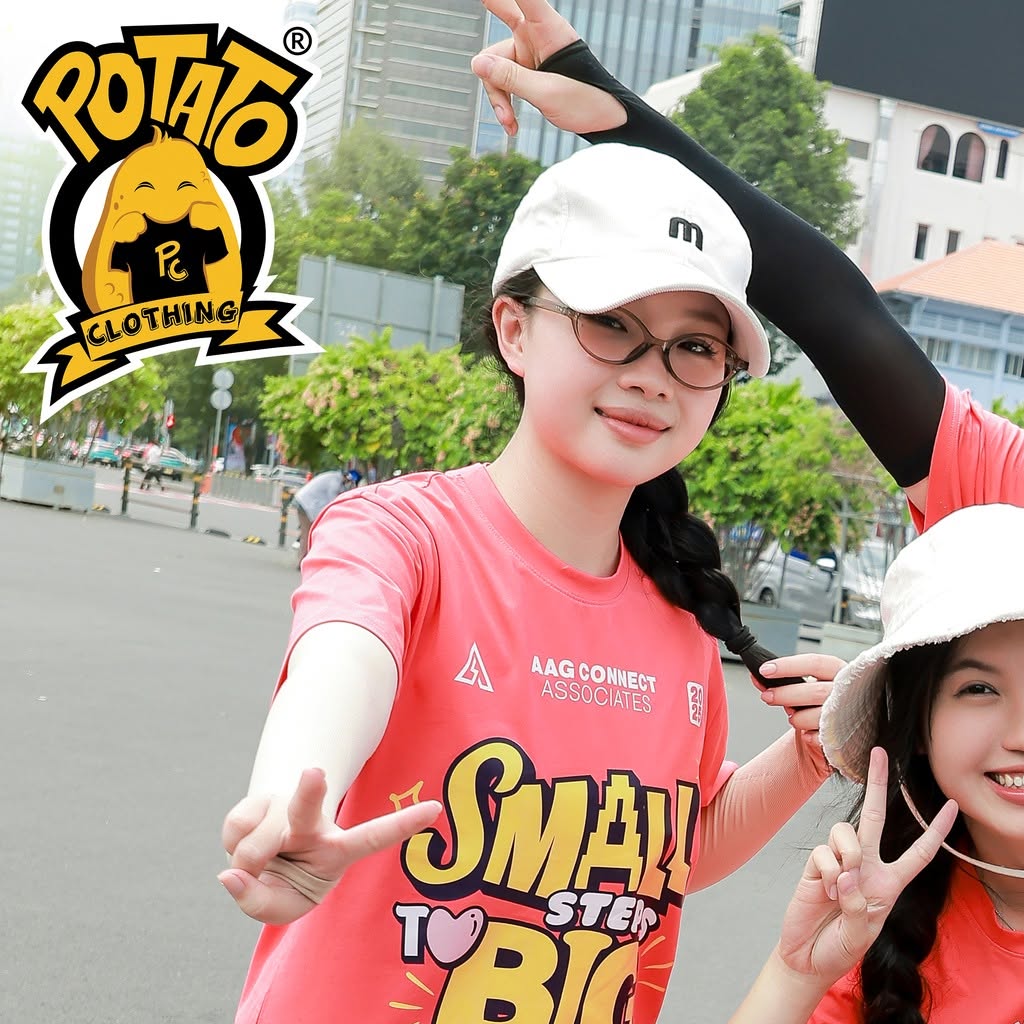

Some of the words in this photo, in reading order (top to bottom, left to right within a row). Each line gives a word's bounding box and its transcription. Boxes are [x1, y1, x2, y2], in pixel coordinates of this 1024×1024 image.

[531, 655, 575, 679] AAG
[578, 661, 657, 694] CONNECT
[540, 679, 652, 714] ASSOCIATES
[402, 739, 697, 906] SMALL
[545, 890, 658, 942] STEPS
